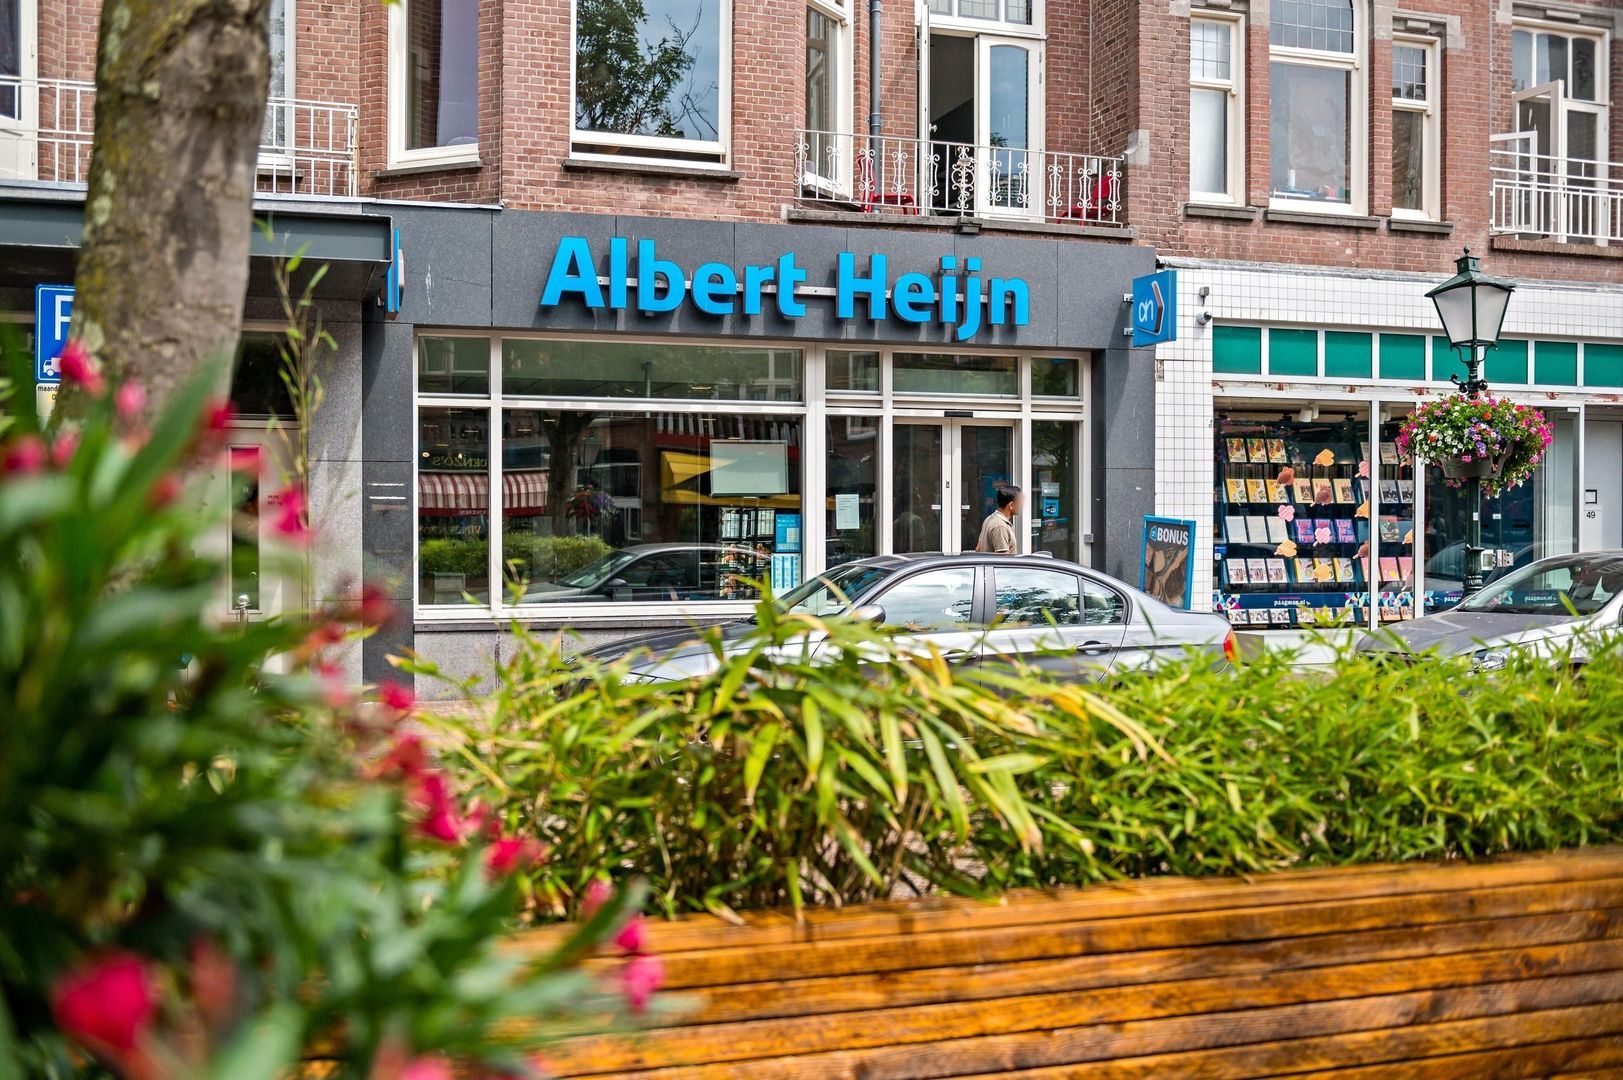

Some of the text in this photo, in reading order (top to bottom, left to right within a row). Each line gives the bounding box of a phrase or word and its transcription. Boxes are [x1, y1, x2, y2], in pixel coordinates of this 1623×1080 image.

[540, 236, 1029, 341] Albert Heijn
[1586, 511, 1596, 519] 49
[1157, 527, 1189, 546] BONUS
